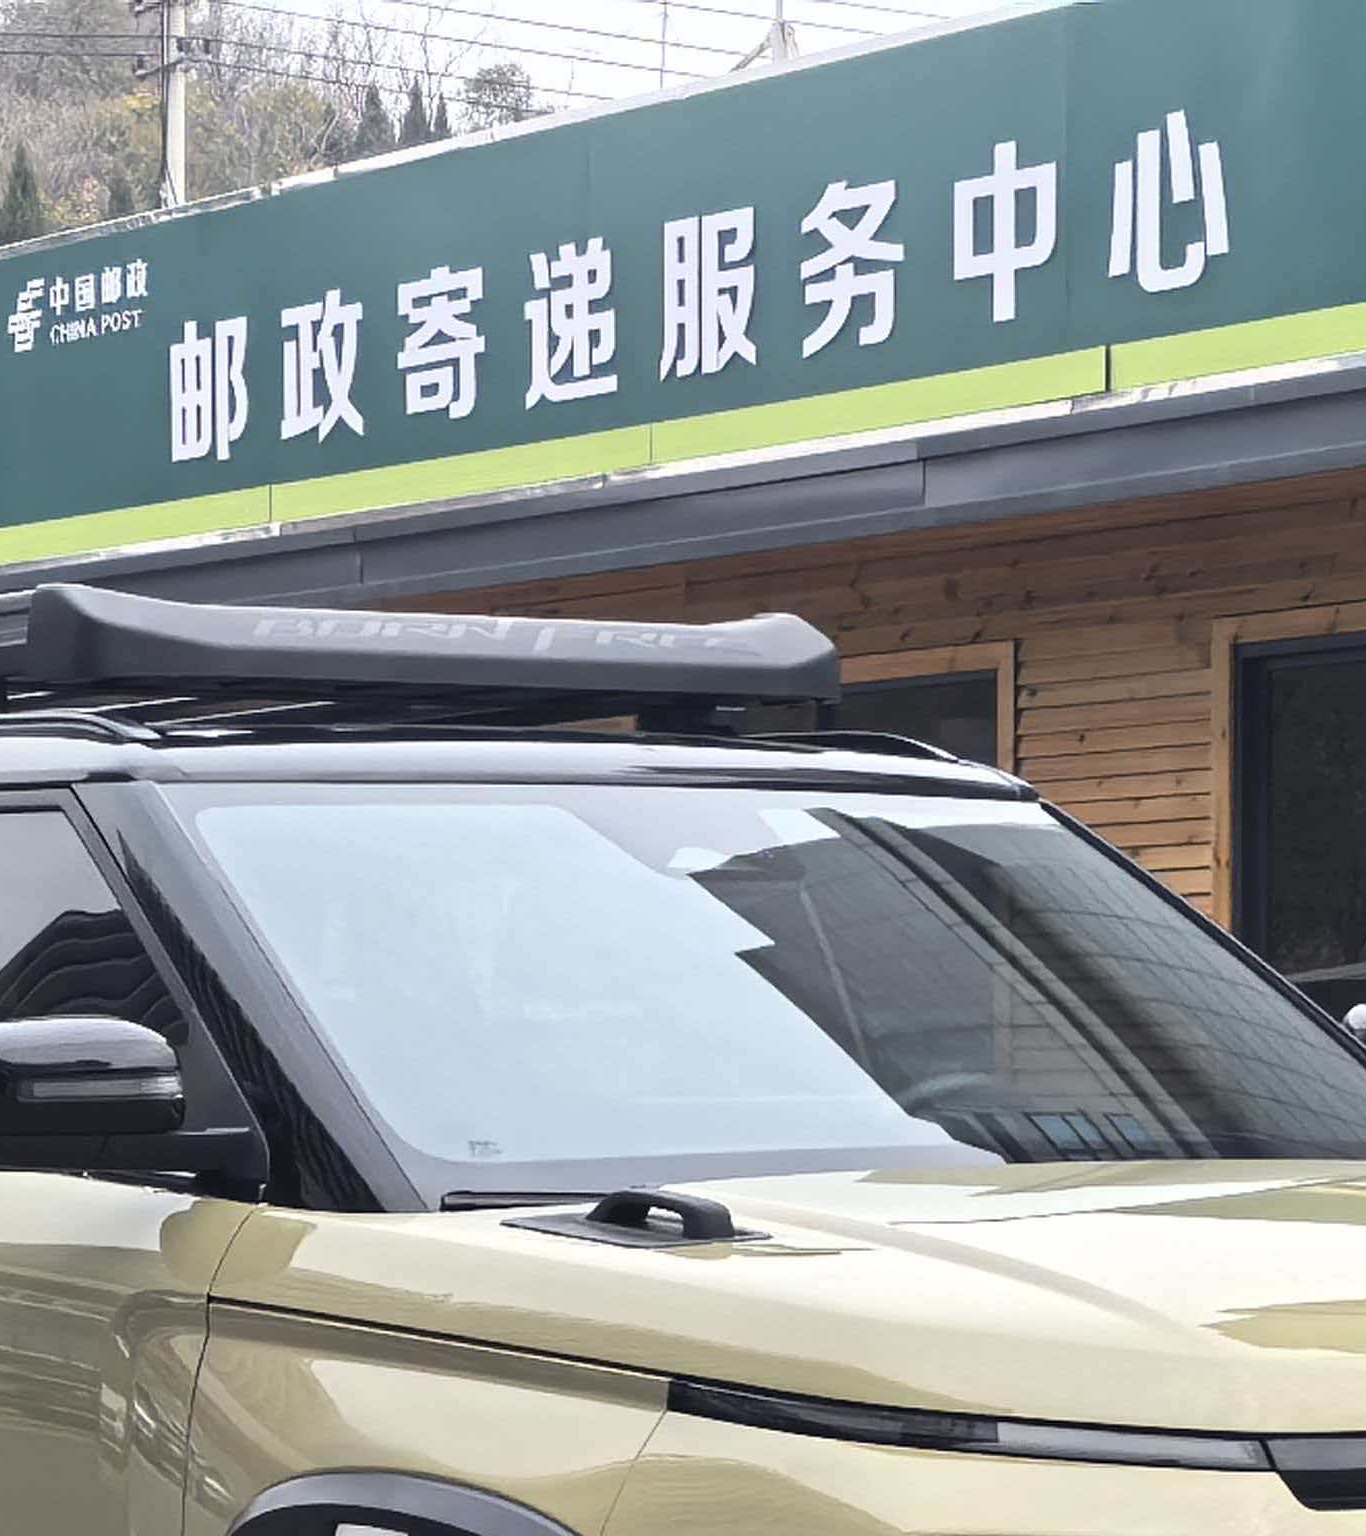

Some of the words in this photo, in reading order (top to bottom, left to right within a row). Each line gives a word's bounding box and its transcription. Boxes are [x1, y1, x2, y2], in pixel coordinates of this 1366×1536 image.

[48, 257, 148, 316] 中国邮政
[169, 109, 1230, 462] 邮政寄递服务中心
[49, 316, 98, 346] CHINA
[101, 308, 143, 334] POST
